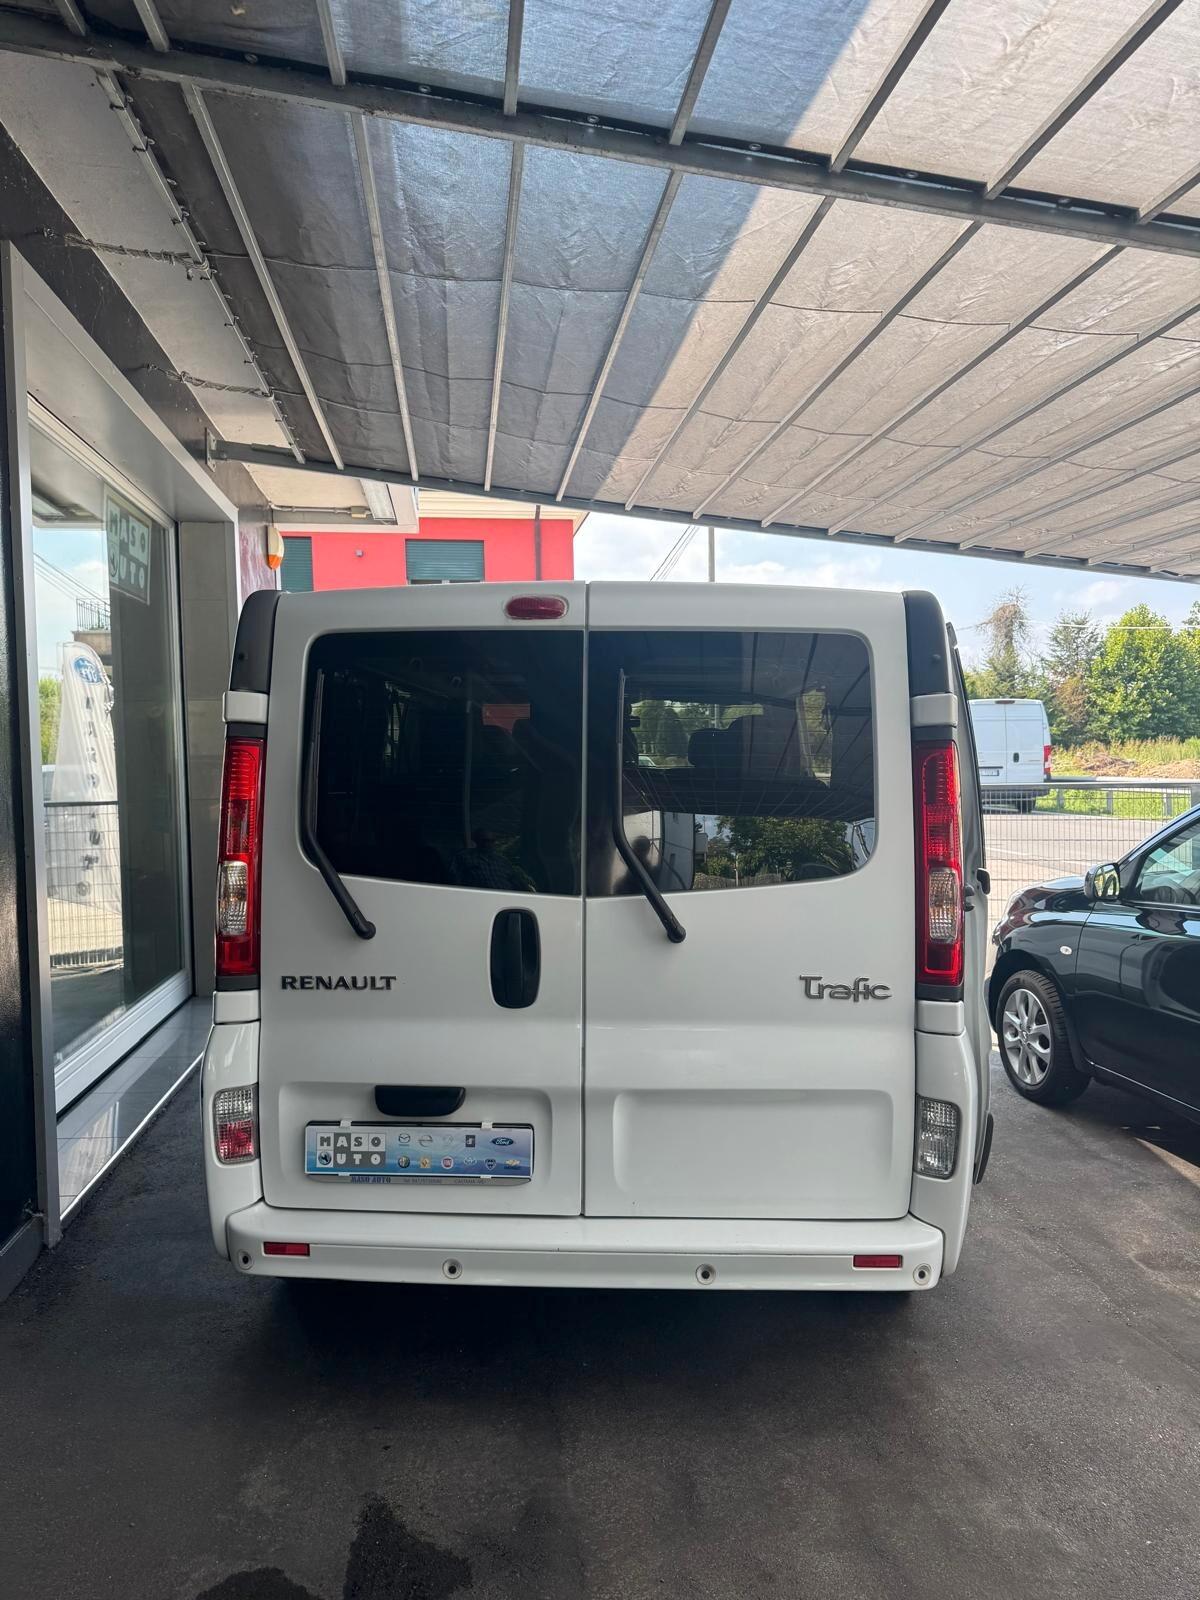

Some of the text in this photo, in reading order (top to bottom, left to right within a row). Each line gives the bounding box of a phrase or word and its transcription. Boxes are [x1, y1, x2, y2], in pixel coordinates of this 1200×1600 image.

[110, 509, 146, 554] MASO
[280, 975, 397, 990] RENAULT
[799, 975, 892, 1003] Trafic
[319, 1135, 382, 1148] MASO
